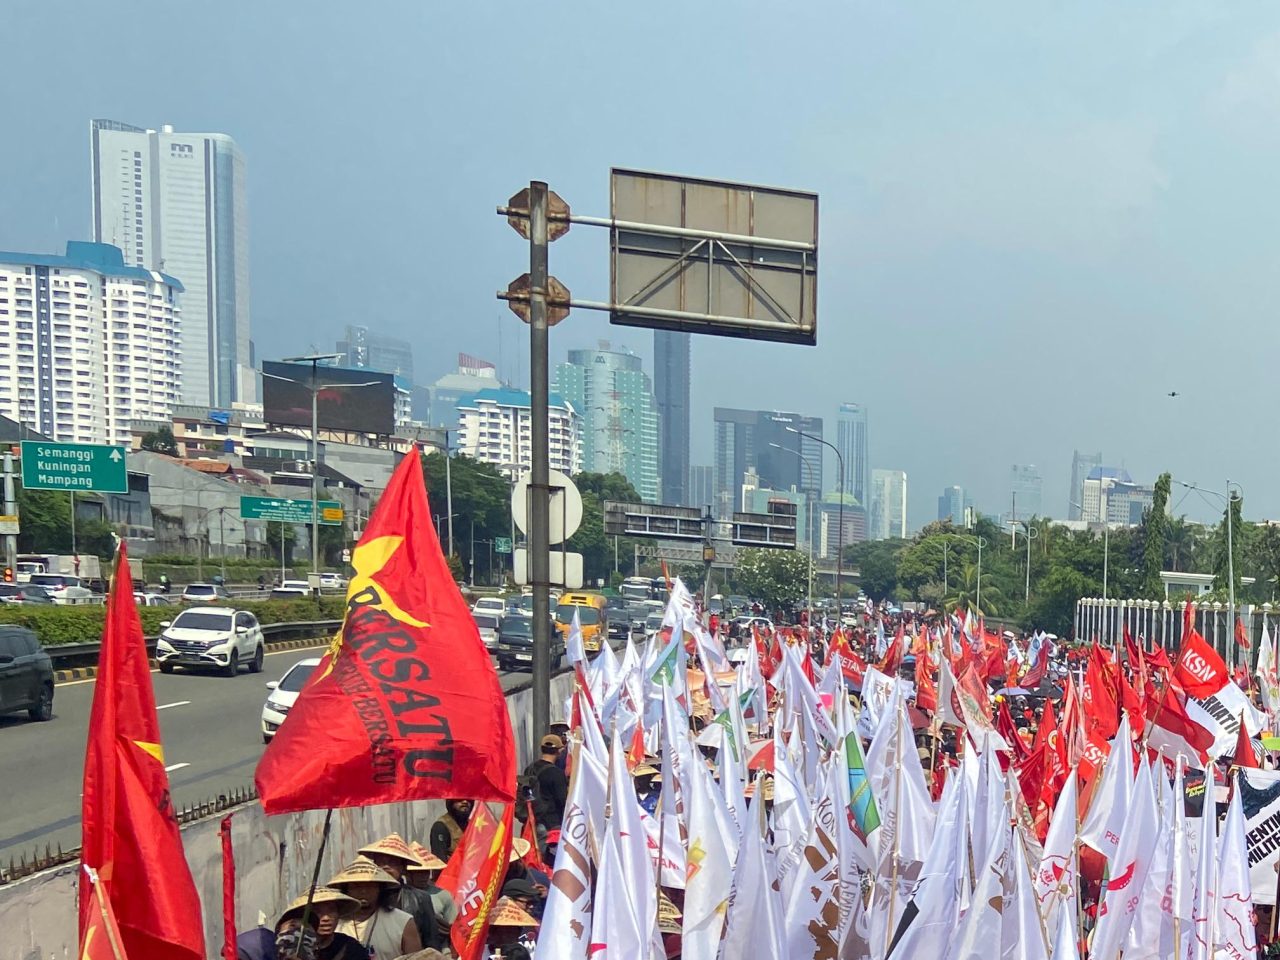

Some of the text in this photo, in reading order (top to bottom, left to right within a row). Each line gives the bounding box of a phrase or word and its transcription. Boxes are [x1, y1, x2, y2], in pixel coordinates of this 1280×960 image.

[38, 447, 94, 461] Semanggi
[38, 461, 91, 474] Kuningan
[38, 474, 93, 488] Mampang
[1182, 648, 1217, 682] KSN
